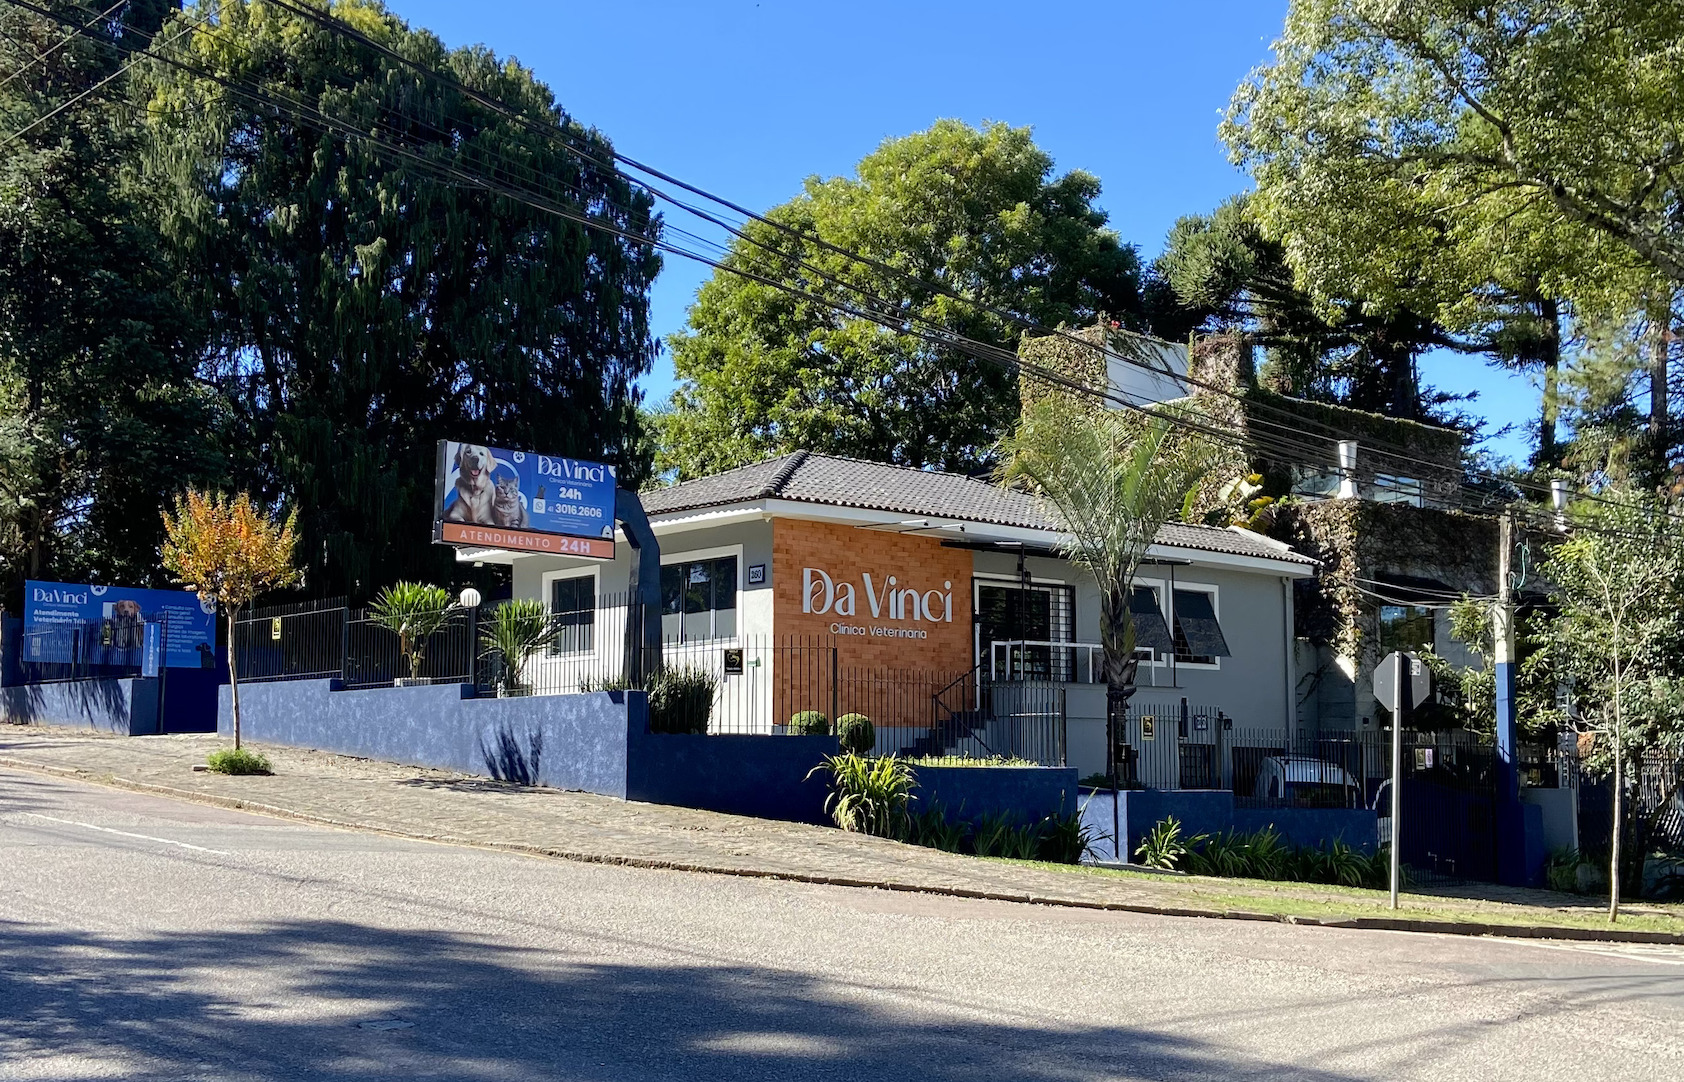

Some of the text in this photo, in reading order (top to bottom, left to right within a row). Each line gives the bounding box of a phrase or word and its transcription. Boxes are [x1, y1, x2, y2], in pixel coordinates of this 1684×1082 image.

[558, 486, 582, 500] 24h
[459, 530, 591, 554] ATENDIMENTO 24H
[802, 567, 953, 623] Da Vinci
[33, 609, 79, 618] Atendimento
